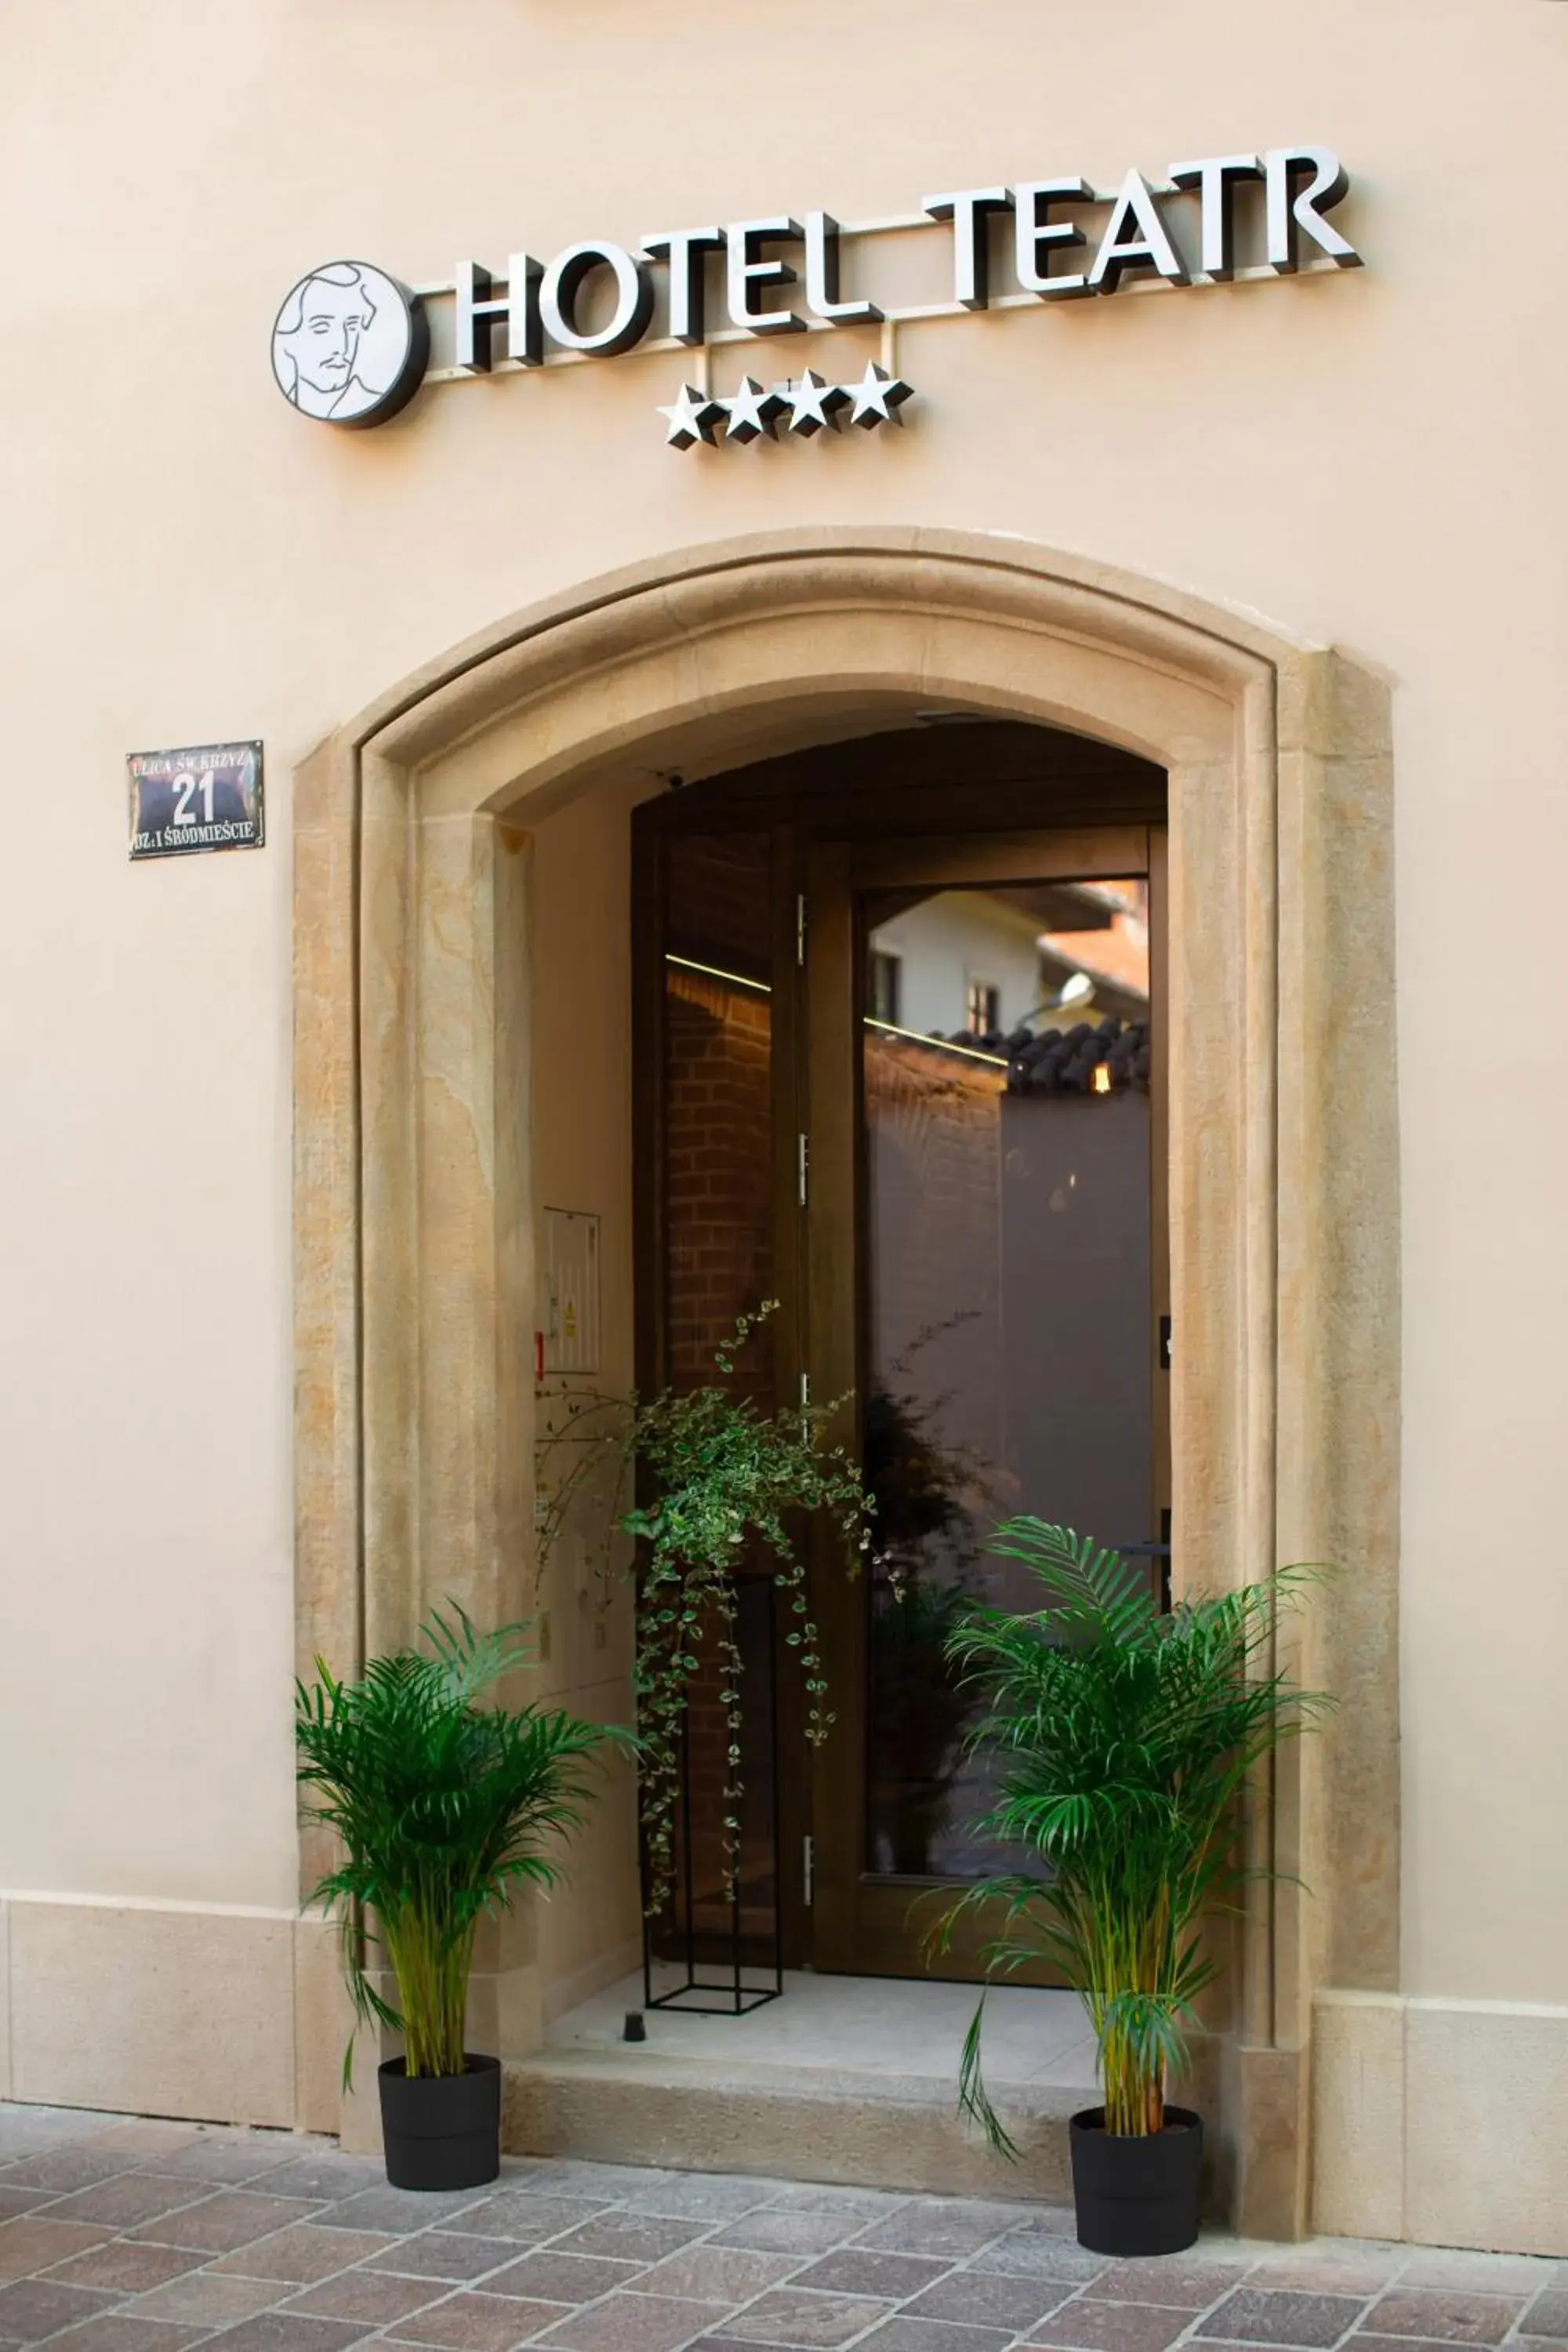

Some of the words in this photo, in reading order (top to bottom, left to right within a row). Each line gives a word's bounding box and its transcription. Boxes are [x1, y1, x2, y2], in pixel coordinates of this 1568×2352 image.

[454, 210, 879, 374] HOTEL
[922, 145, 1364, 310] TEATR
[172, 770, 214, 826] 21
[164, 821, 253, 847] ŚRÓDMIEŚCIE
